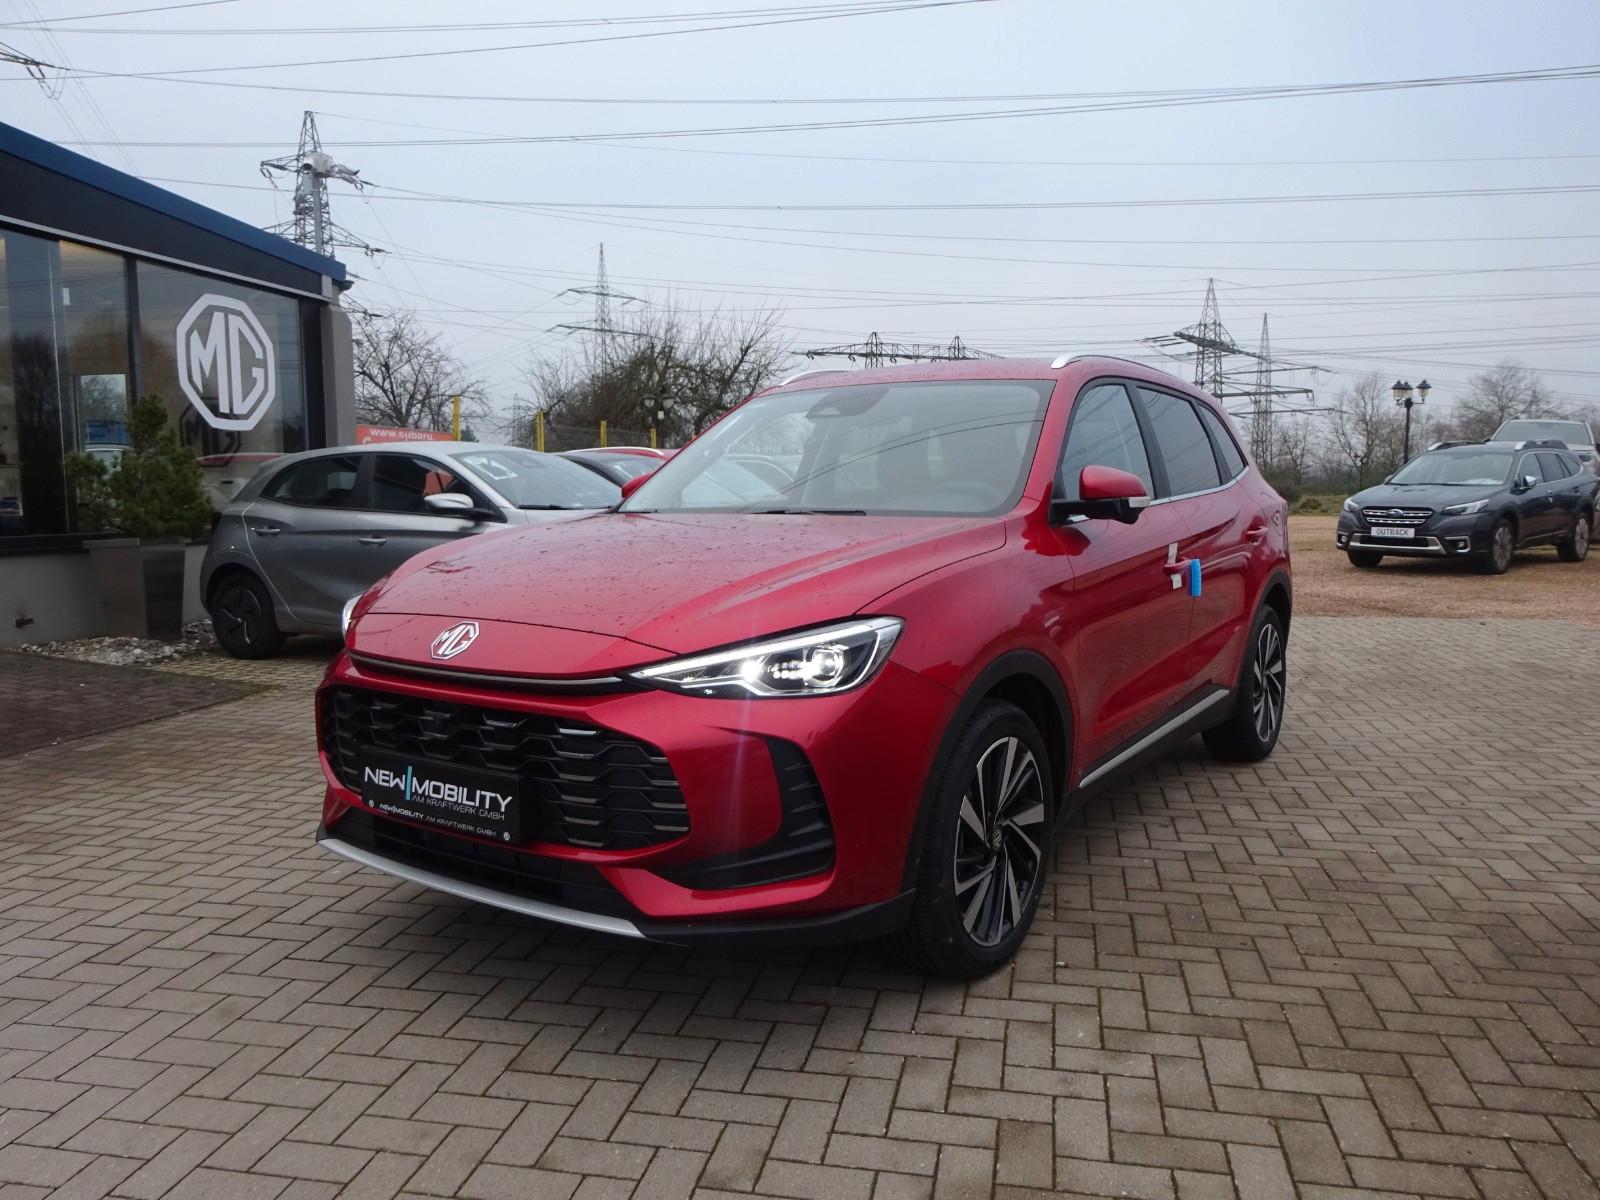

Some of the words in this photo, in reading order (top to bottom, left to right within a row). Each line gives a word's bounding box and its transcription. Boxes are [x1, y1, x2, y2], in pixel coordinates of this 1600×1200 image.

[190, 311, 265, 415] MG
[1376, 528, 1409, 536] OUTBACK
[434, 624, 476, 655] MG
[411, 795, 425, 804] AM
[426, 798, 476, 815] KRAFTWERK
[478, 809, 505, 821] GMBH
[437, 818, 475, 832] KRAFTWERK
[476, 827, 497, 837] GMBH
